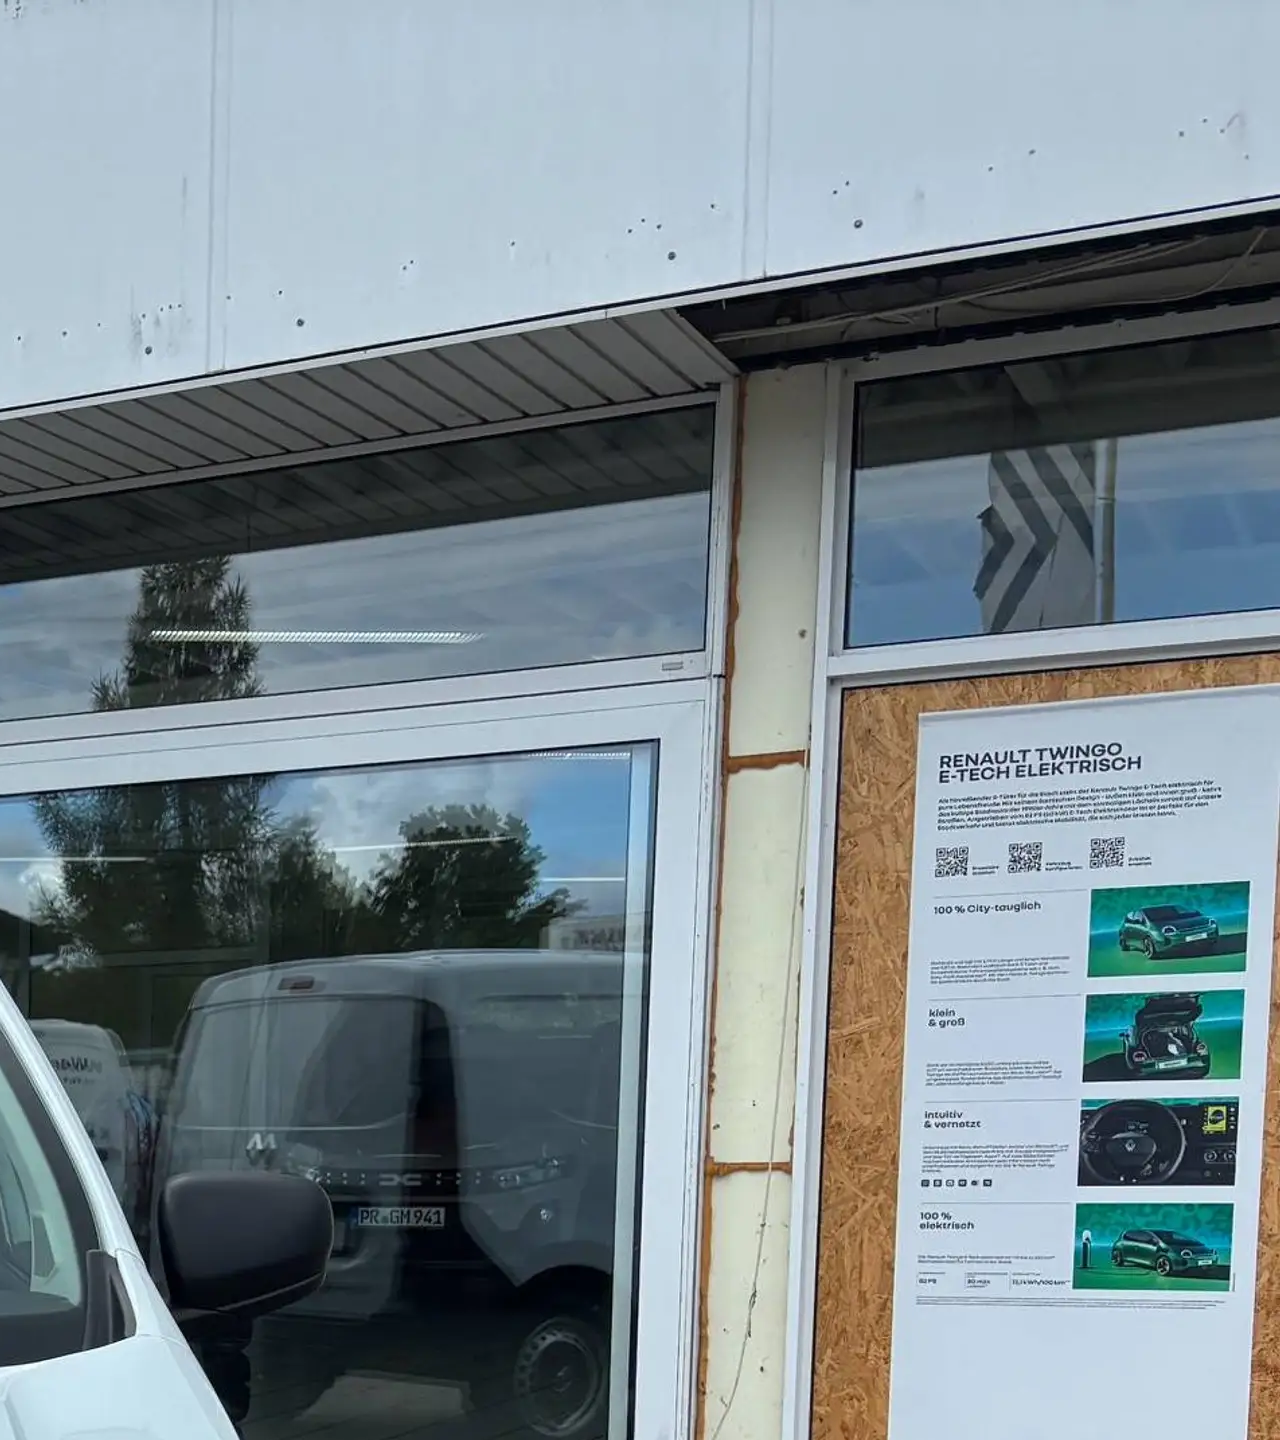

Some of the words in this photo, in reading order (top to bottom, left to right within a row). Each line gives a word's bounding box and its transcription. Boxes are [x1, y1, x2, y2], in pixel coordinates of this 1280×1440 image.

[939, 748, 1032, 769] RENAULT
[1035, 742, 1123, 762] TWINGO
[938, 765, 1010, 784] E-TECH
[1015, 755, 1142, 779] ELEKTRISCH
[934, 905, 953, 915] 100
[967, 901, 1042, 915] City-tauglich
[928, 1008, 956, 1018] klein
[924, 1109, 964, 1119] intuitiv
[934, 1120, 982, 1129] vernetzt
[360, 1208, 380, 1225] PR
[389, 1208, 411, 1225] GM
[413, 1208, 443, 1225] 941
[920, 1211, 940, 1221] 100
[919, 1221, 975, 1230] elektrisch
